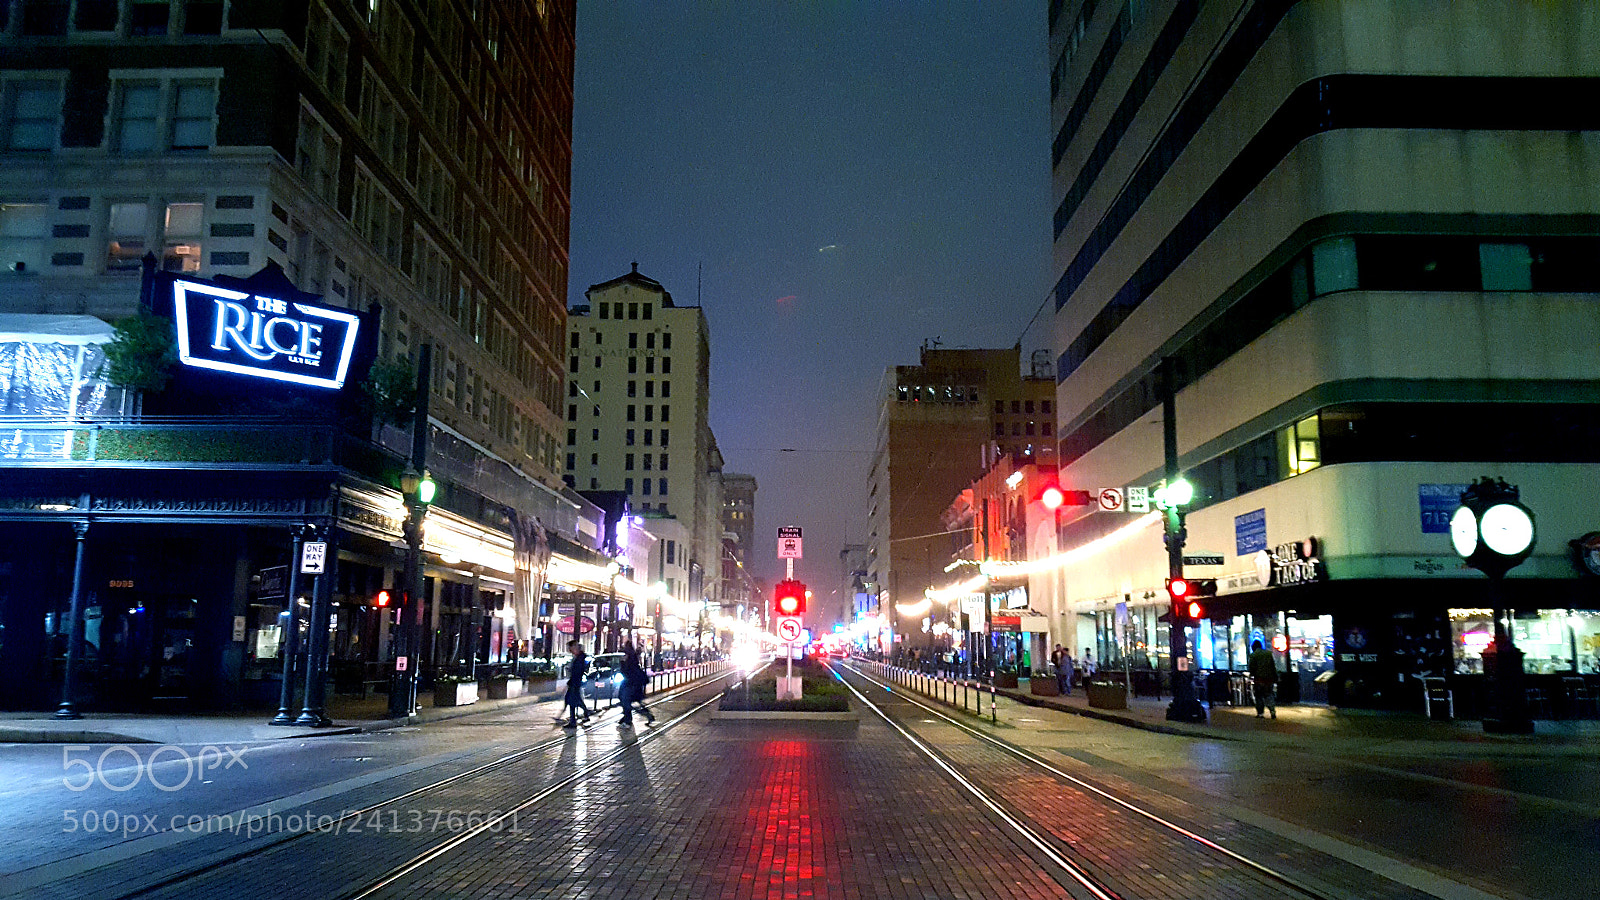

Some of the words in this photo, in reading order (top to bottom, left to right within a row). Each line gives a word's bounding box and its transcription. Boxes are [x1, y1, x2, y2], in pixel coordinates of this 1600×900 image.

[255, 295, 287, 314] THE
[211, 299, 323, 360] RICE
[1190, 557, 1217, 565] TEXAS
[1273, 564, 1300, 584] TACO
